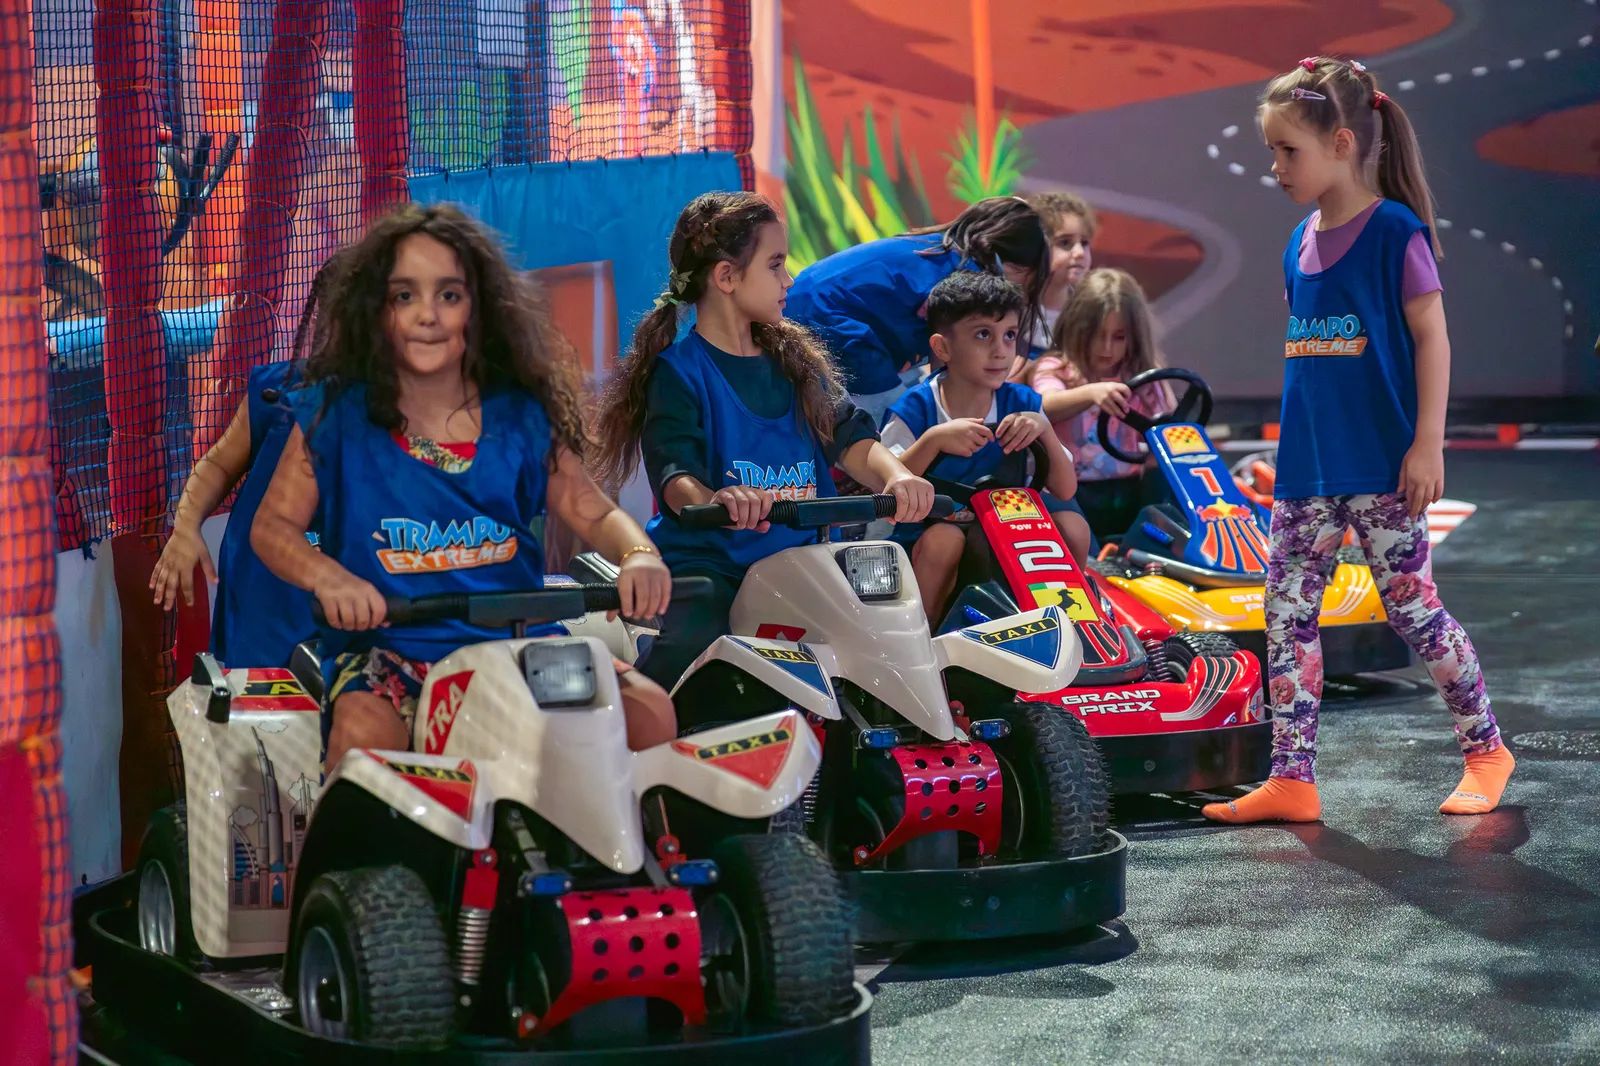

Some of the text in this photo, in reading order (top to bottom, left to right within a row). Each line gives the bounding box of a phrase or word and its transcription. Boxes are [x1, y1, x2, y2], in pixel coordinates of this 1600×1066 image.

[1287, 314, 1360, 341] RAMPO
[1285, 340, 1363, 354] EXTREME
[386, 543, 513, 569] EXTREME
[1012, 540, 1074, 573] 2
[990, 622, 1047, 641] TAXI
[760, 649, 808, 661] TAXI
[1061, 690, 1161, 705] GRAND
[1079, 701, 1157, 716] PRIX
[708, 733, 777, 756] TAXI
